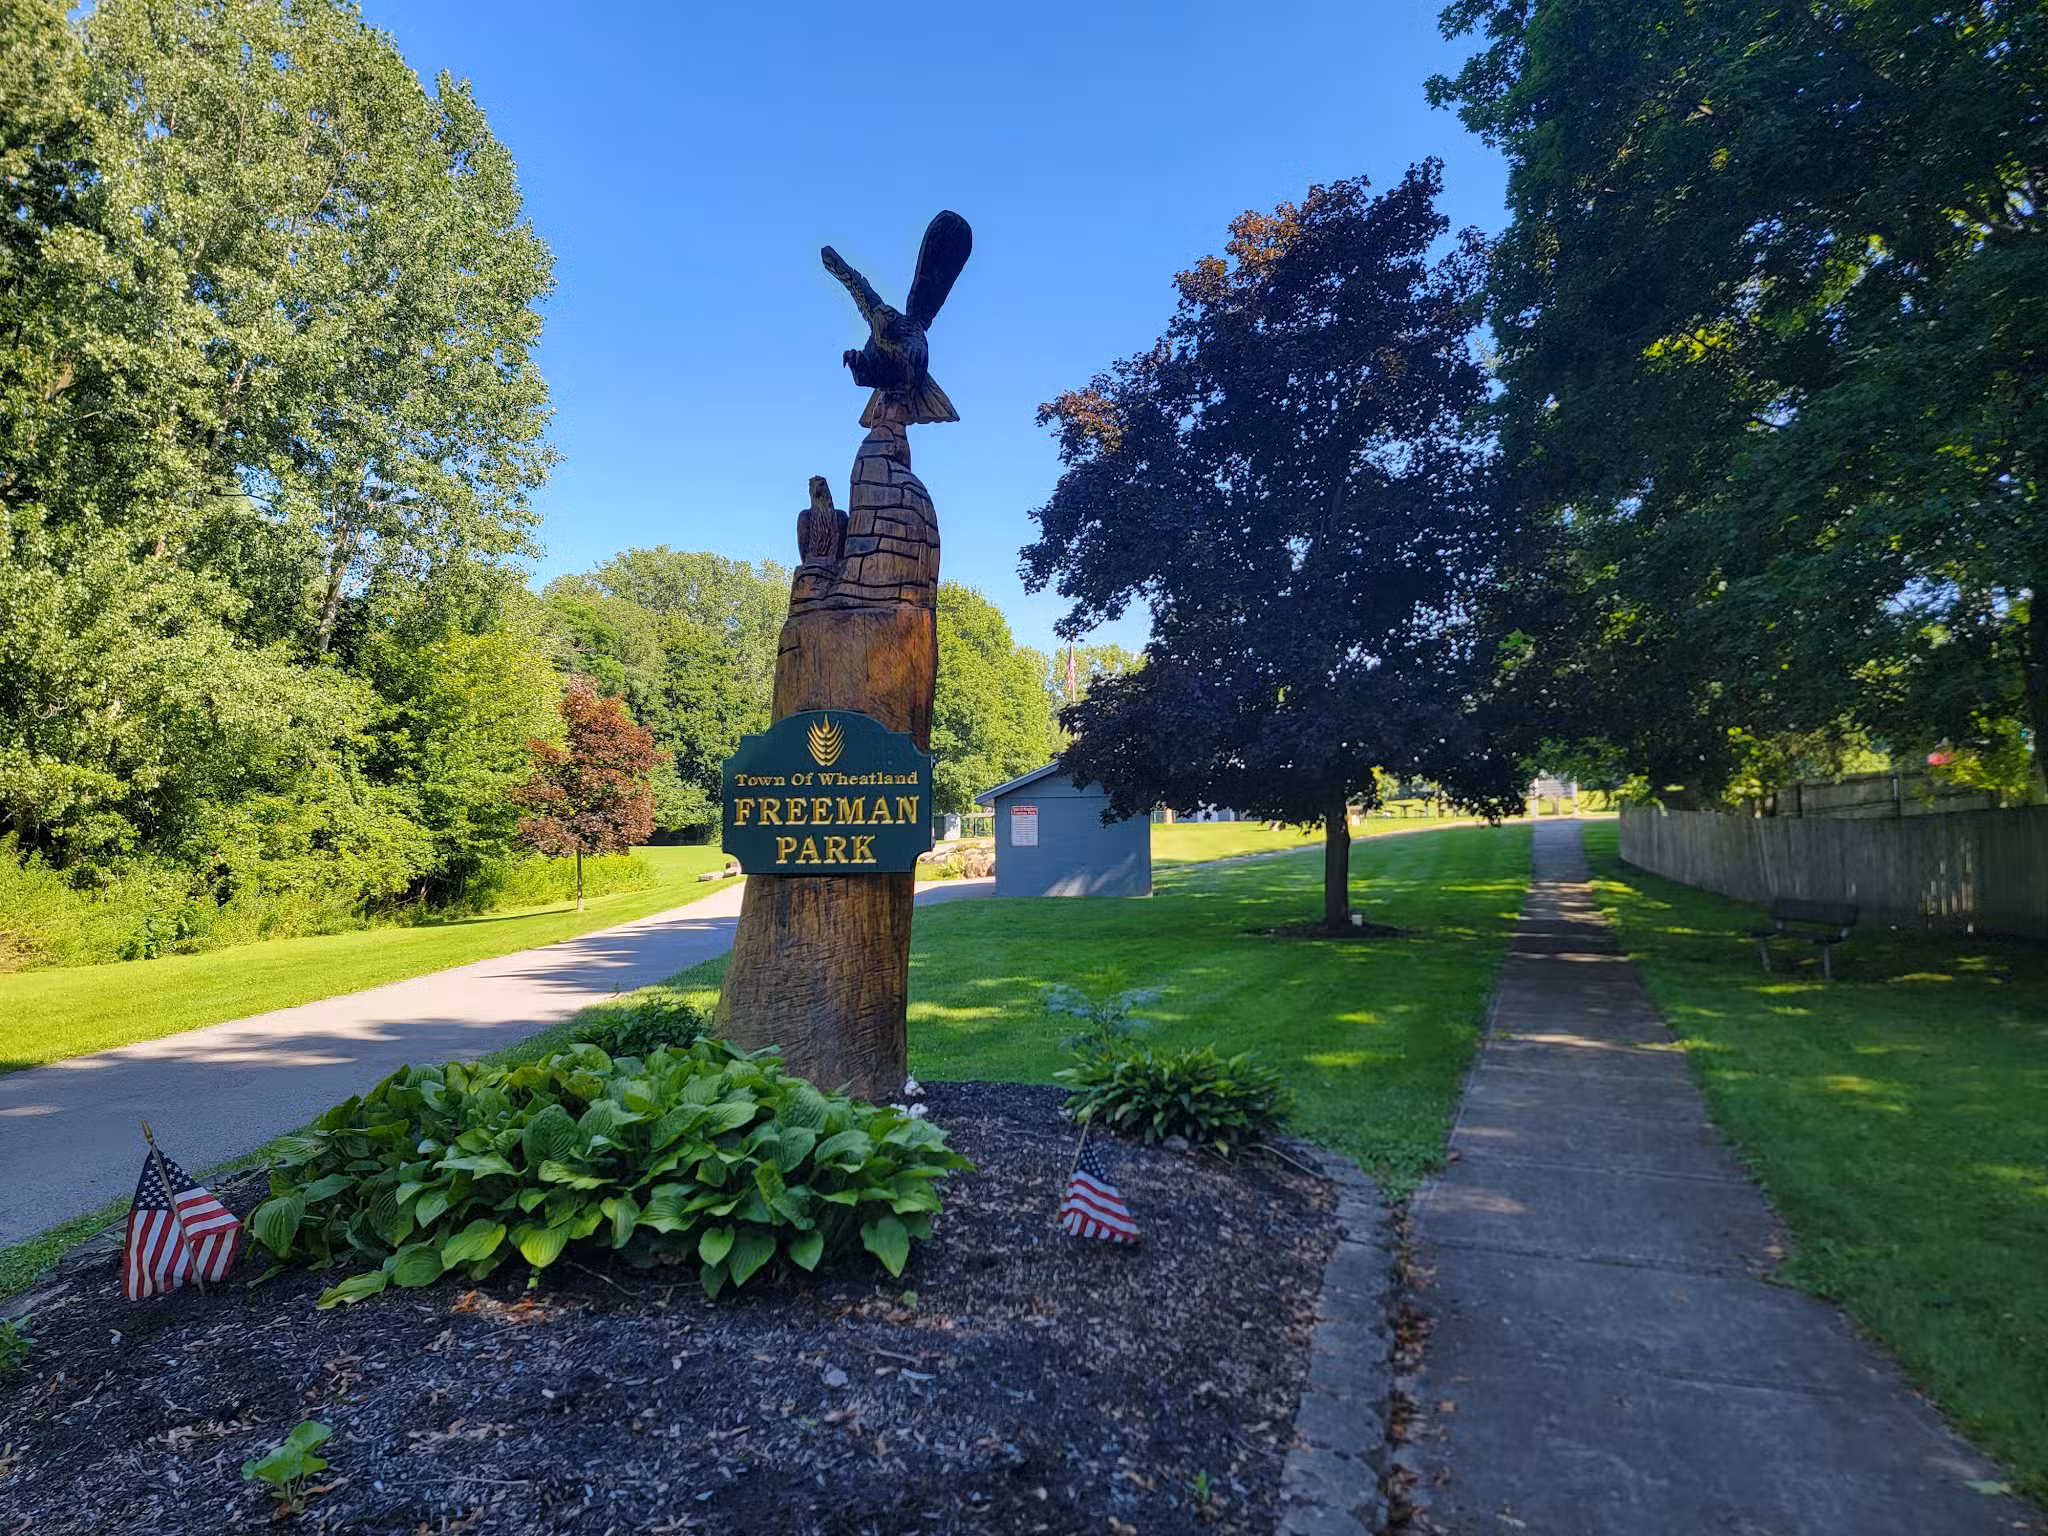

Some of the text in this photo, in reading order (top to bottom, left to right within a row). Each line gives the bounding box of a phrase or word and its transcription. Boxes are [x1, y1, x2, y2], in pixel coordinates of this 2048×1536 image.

[735, 771, 918, 787] Town Of Wheatland
[733, 795, 920, 826] FREEMAN
[776, 834, 877, 865] PARK
